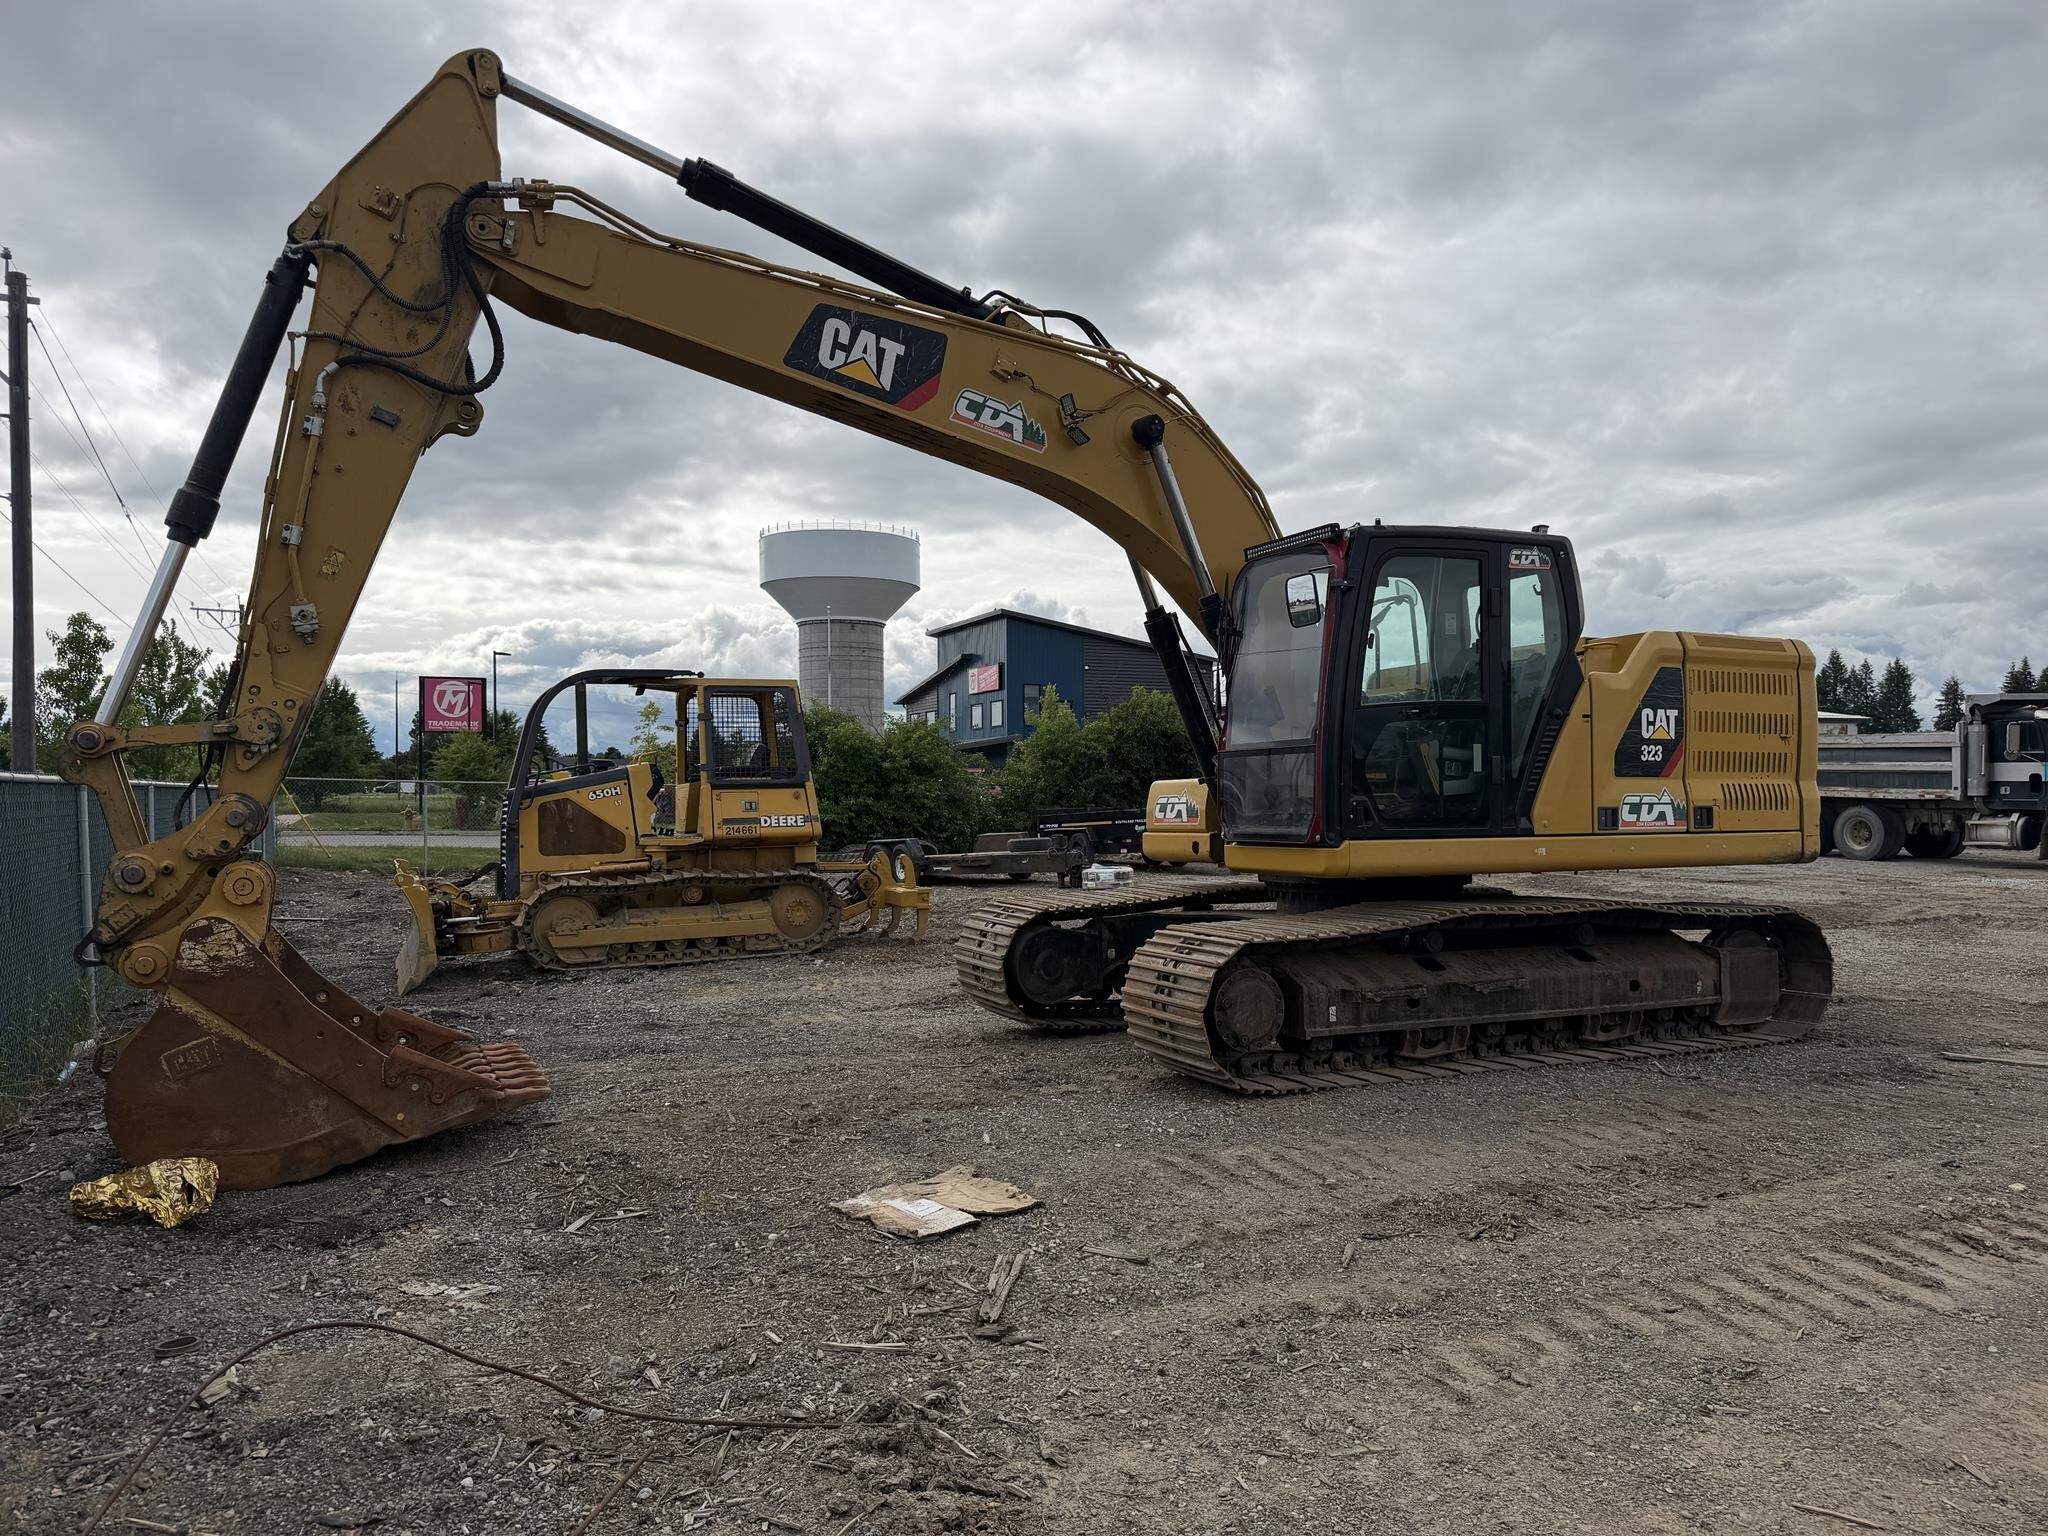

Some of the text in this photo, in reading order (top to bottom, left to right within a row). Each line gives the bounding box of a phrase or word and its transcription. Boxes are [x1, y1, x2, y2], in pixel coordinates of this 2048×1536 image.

[818, 317, 905, 391] CAT
[955, 389, 1024, 444] CDA
[1641, 708, 1678, 739] CAT
[1640, 745, 1663, 761] 323
[588, 786, 621, 801] 650H
[1621, 789, 1675, 826] CDA
[725, 825, 758, 836] 214661
[760, 815, 805, 828] DEERE
